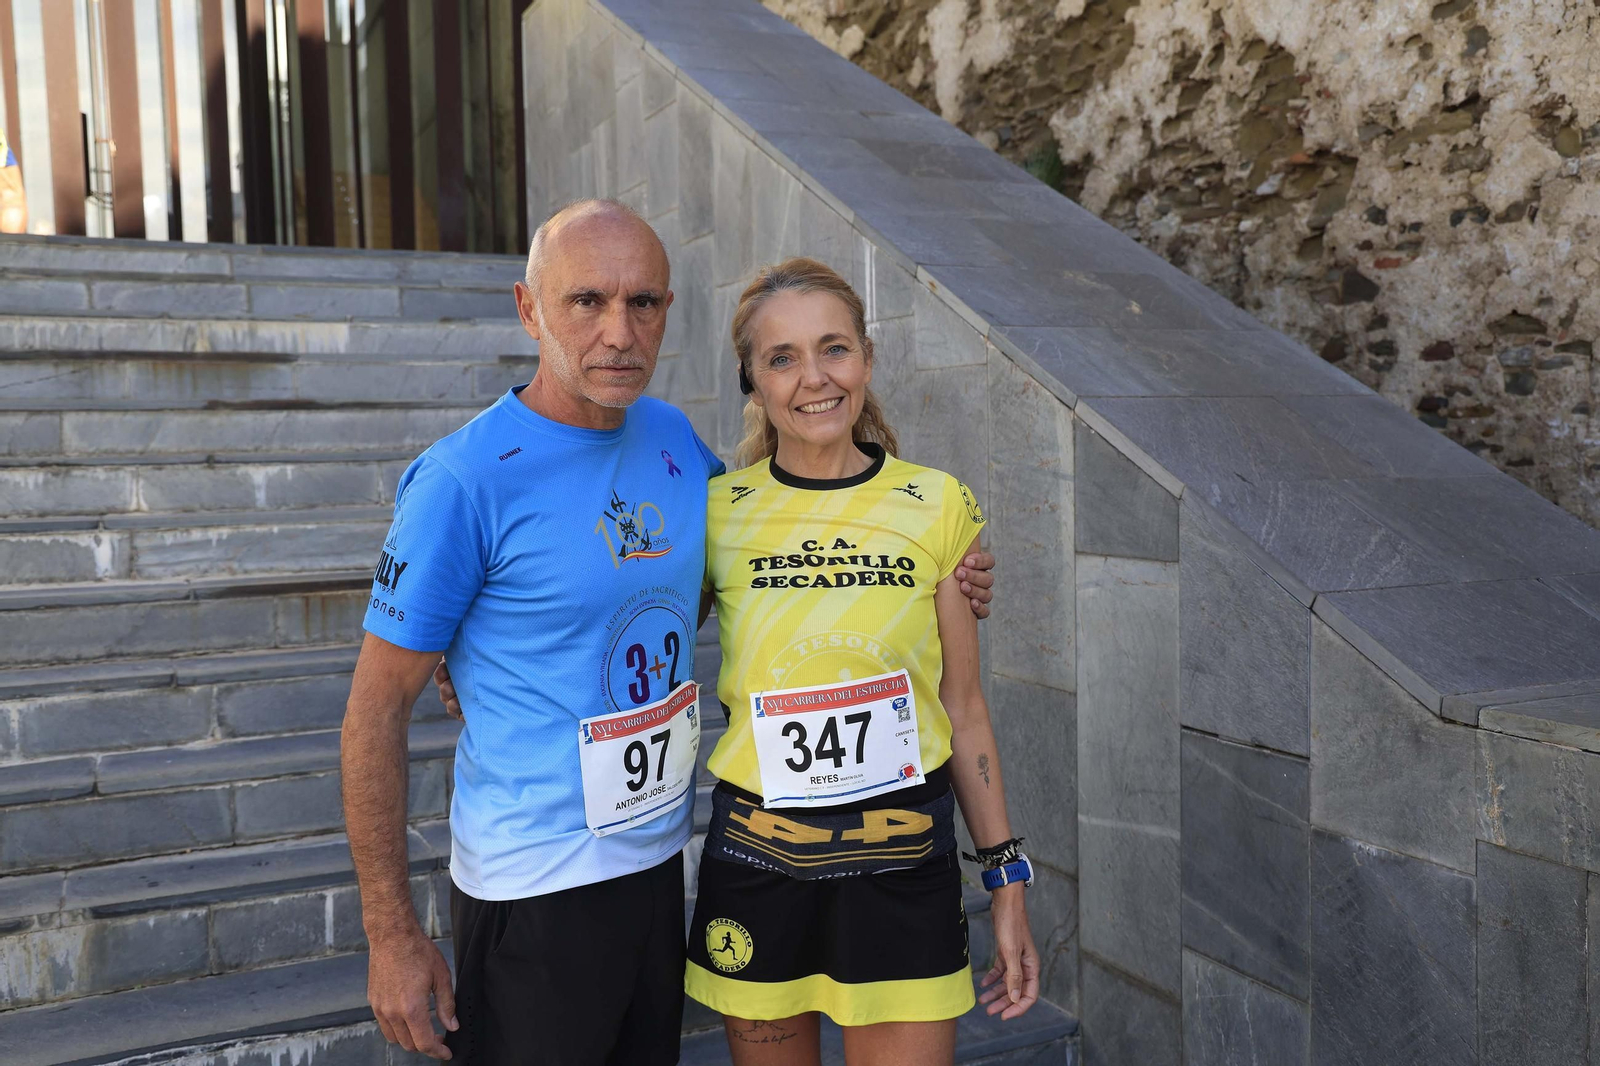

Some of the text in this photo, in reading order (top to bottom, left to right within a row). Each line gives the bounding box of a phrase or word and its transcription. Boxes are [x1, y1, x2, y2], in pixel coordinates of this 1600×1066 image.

[801, 537, 857, 552] C. A.
[750, 570, 916, 589] SECADERO
[639, 587, 649, 598] DE
[651, 586, 689, 607] SACRIFICIO
[626, 631, 681, 705] 3+2
[766, 678, 906, 711] XVI CARRERA DEL ESTRECHO
[594, 723, 612, 736] XVI
[613, 712, 656, 731] CARRERA
[895, 728, 915, 737] CAMISETA
[781, 710, 872, 773] 347
[903, 738, 909, 746] S
[623, 728, 671, 793] 97
[810, 773, 839, 785] REYES
[615, 792, 648, 811] ANTONIO
[648, 784, 667, 798] JOSE
[715, 918, 752, 948] TESORILLO
